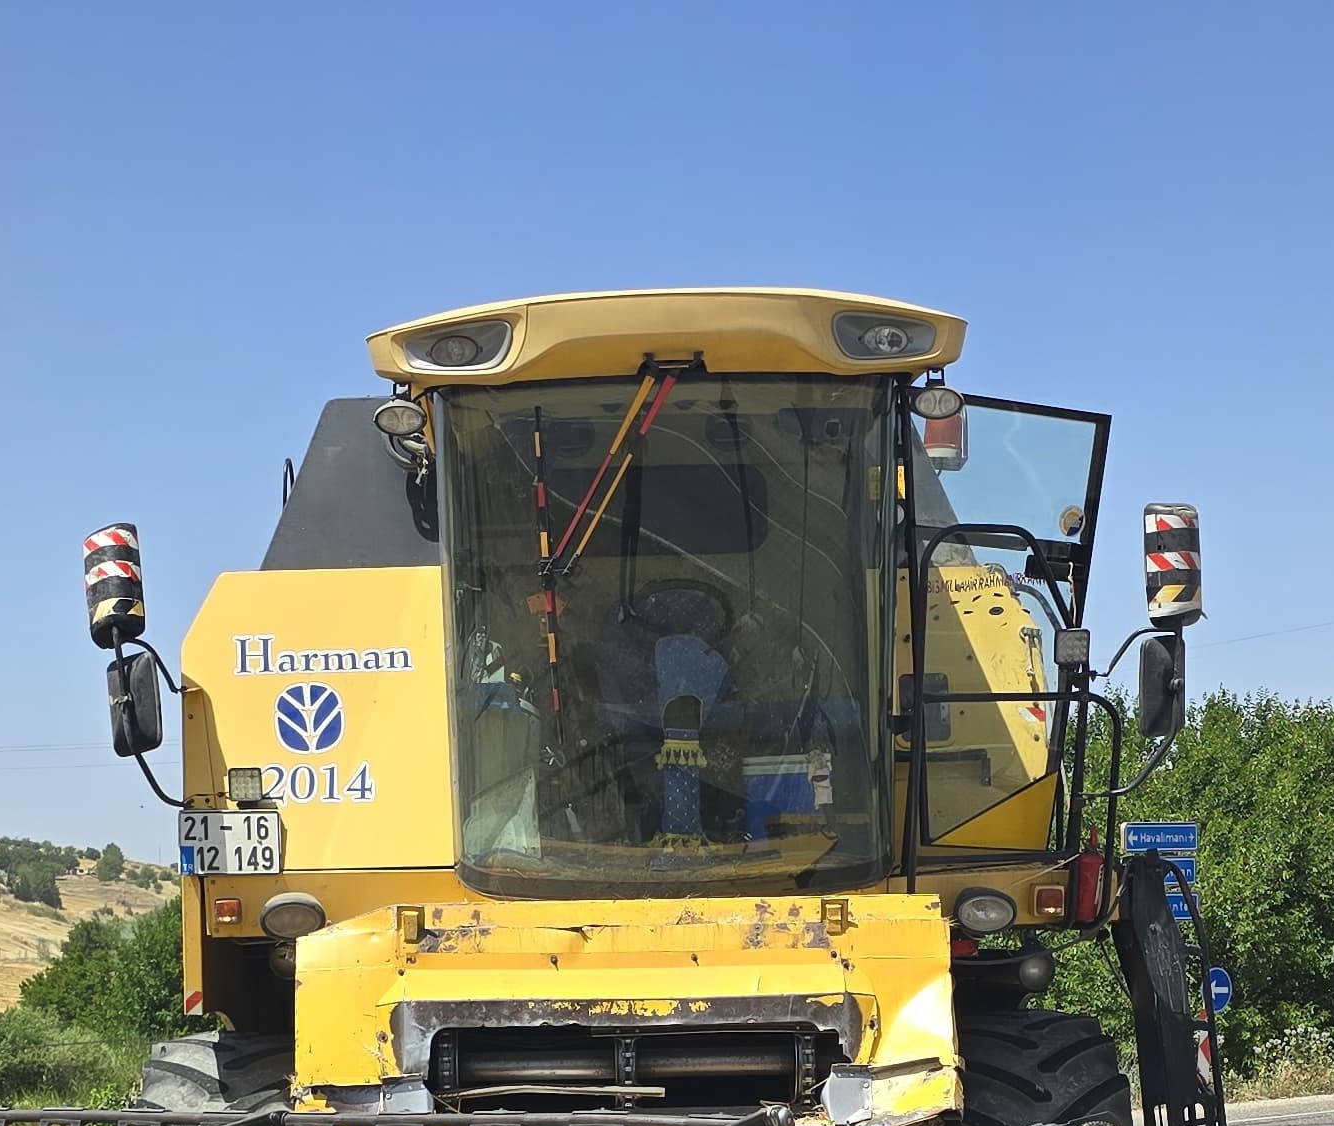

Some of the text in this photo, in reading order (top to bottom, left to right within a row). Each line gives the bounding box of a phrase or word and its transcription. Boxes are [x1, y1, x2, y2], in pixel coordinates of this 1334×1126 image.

[234, 636, 413, 674] Harman
[261, 764, 373, 802] 2014
[234, 846, 274, 871] 149
